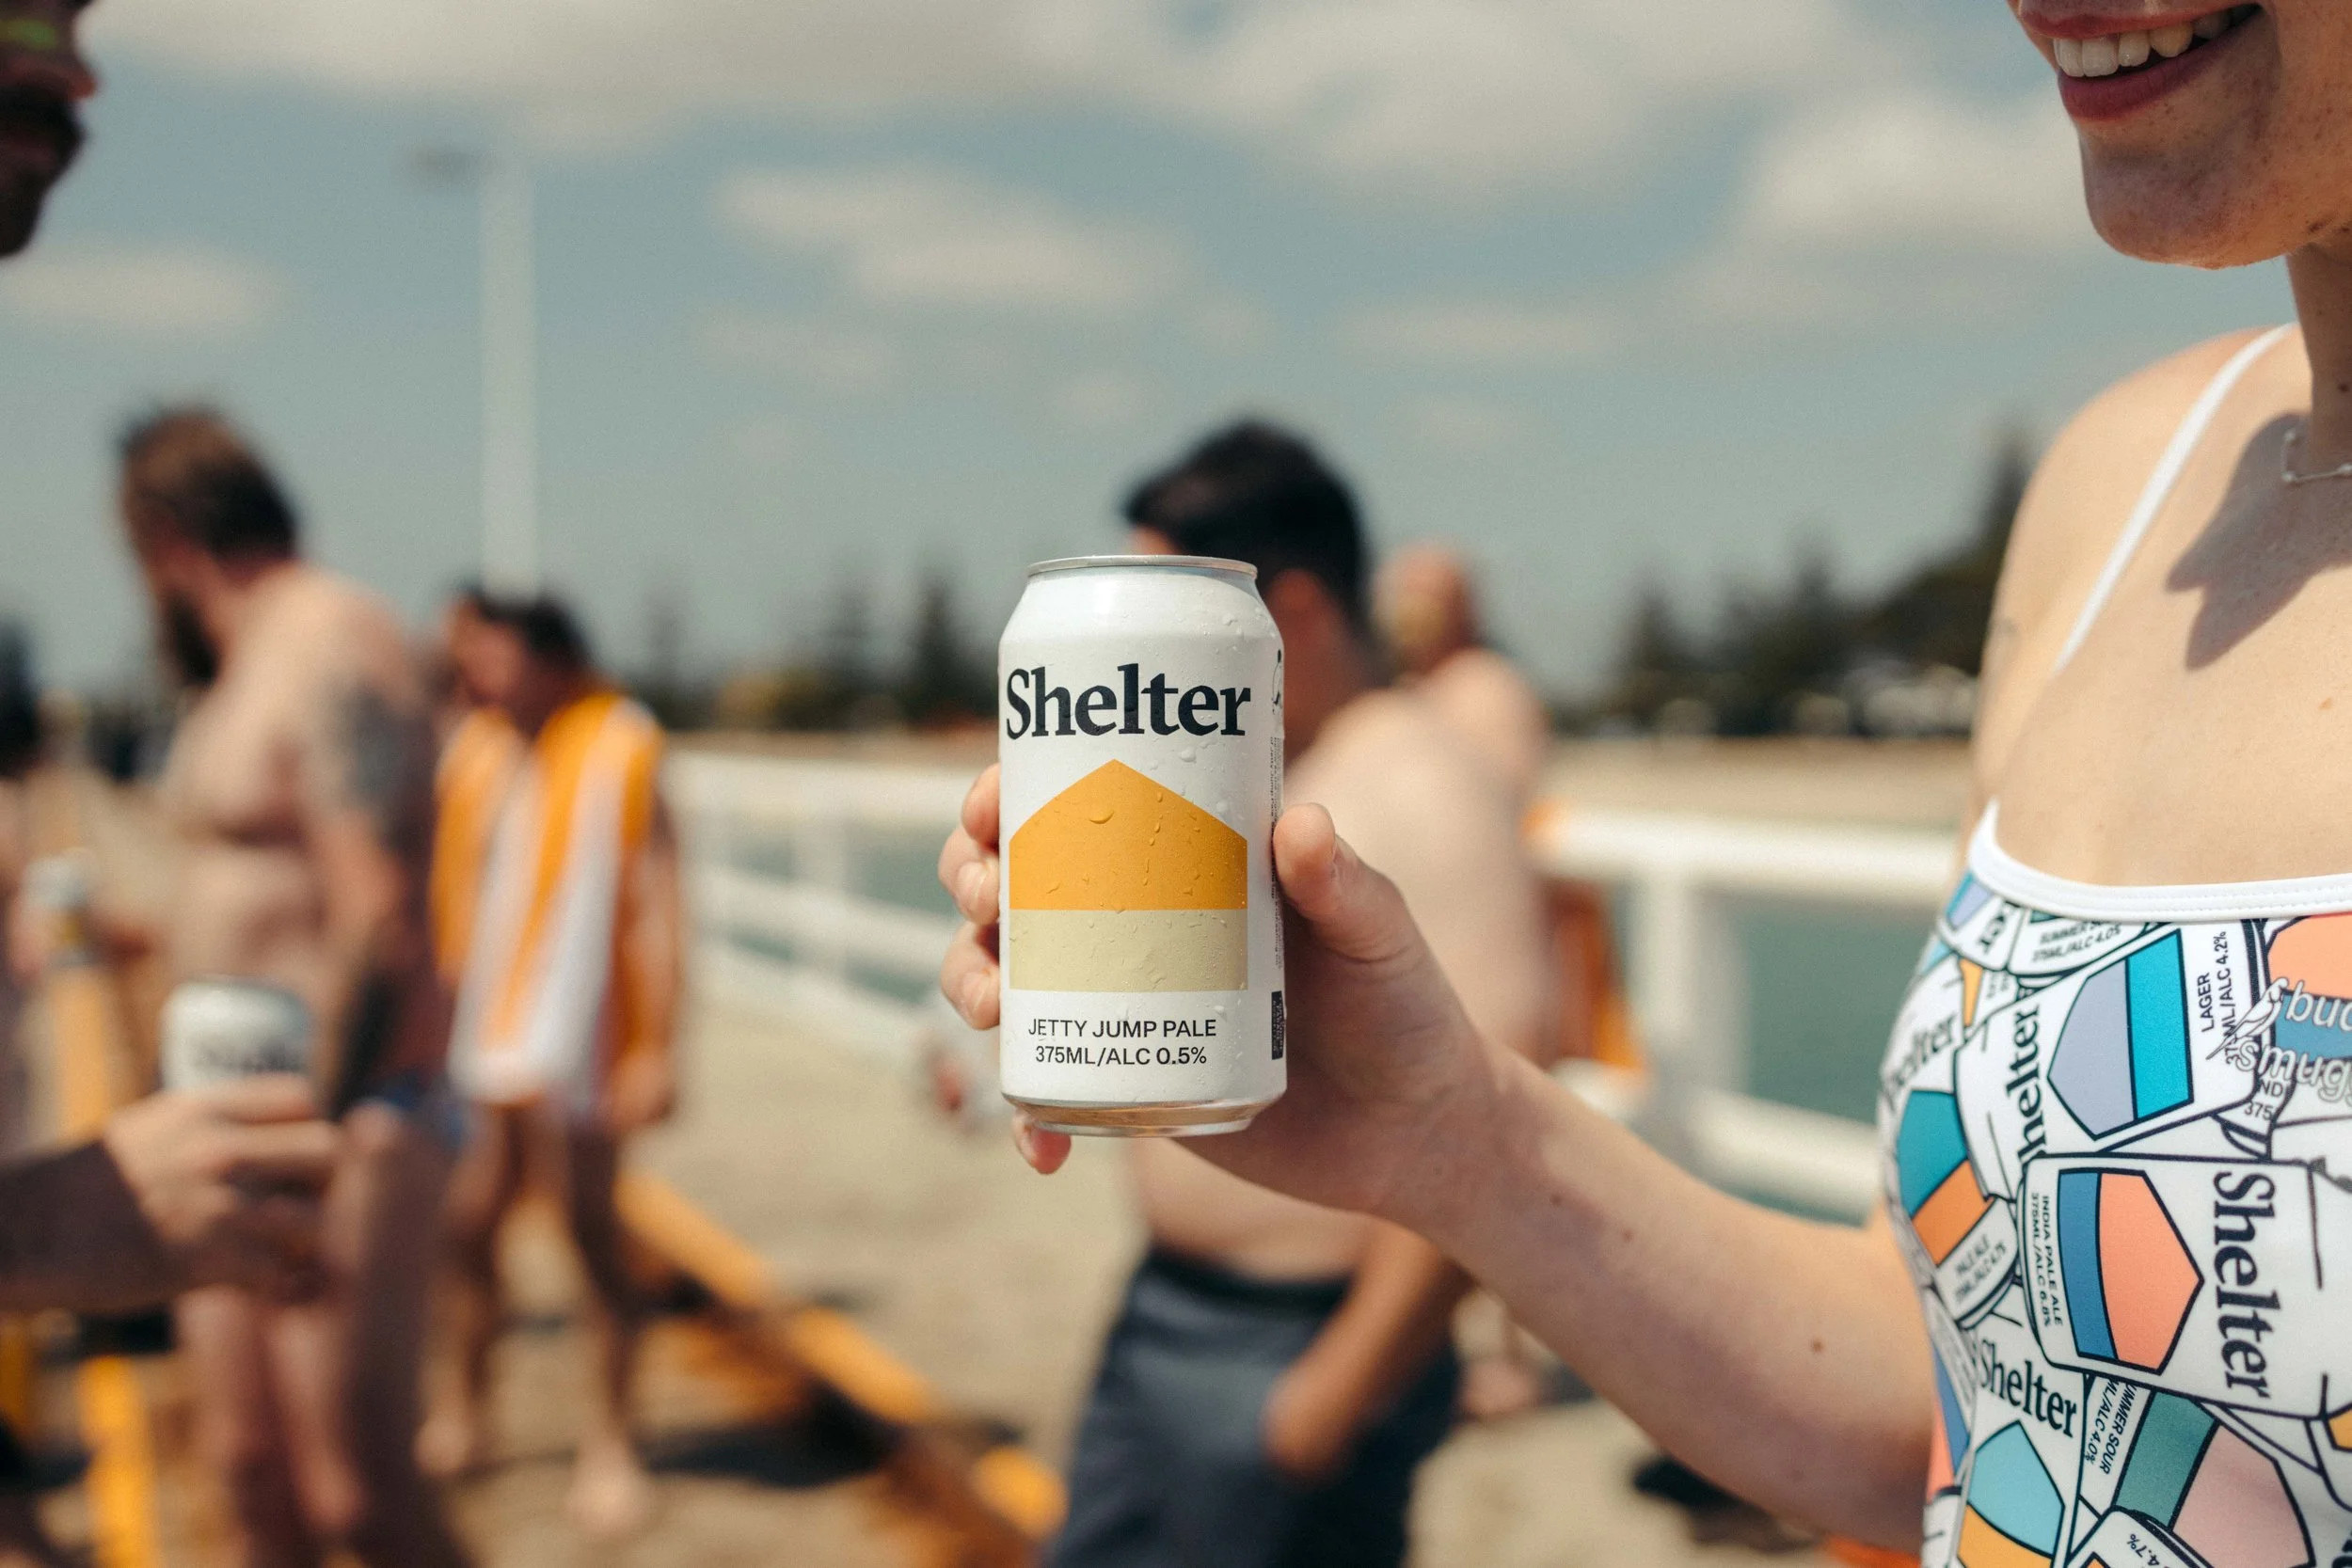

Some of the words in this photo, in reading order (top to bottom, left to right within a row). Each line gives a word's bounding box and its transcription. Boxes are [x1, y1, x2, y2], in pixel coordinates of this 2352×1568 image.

[1006, 662, 1251, 740] Shelter
[2213, 931, 2229, 965] 4.2%
[2197, 972, 2215, 1032] LAGER
[1028, 1019, 1088, 1037] JETTY
[1092, 1021, 1157, 1038] JUMP
[1163, 1020, 1216, 1037] PALE
[1035, 1045, 1151, 1067] 375ML/ALC
[1156, 1046, 1207, 1065] 0.5%
[2005, 1003, 2047, 1163] helter
[2042, 1196, 2051, 1241] INDIA
[2044, 1245, 2058, 1291] PALE
[2214, 1171, 2281, 1399] Shelter
[2051, 1294, 2063, 1326] ALE
[1978, 1338, 2077, 1438] Shelter
[2095, 1380, 2120, 1432] ML/ALC
[2112, 1384, 2137, 1435] UMMER
[2100, 1433, 2120, 1475] SOUR
